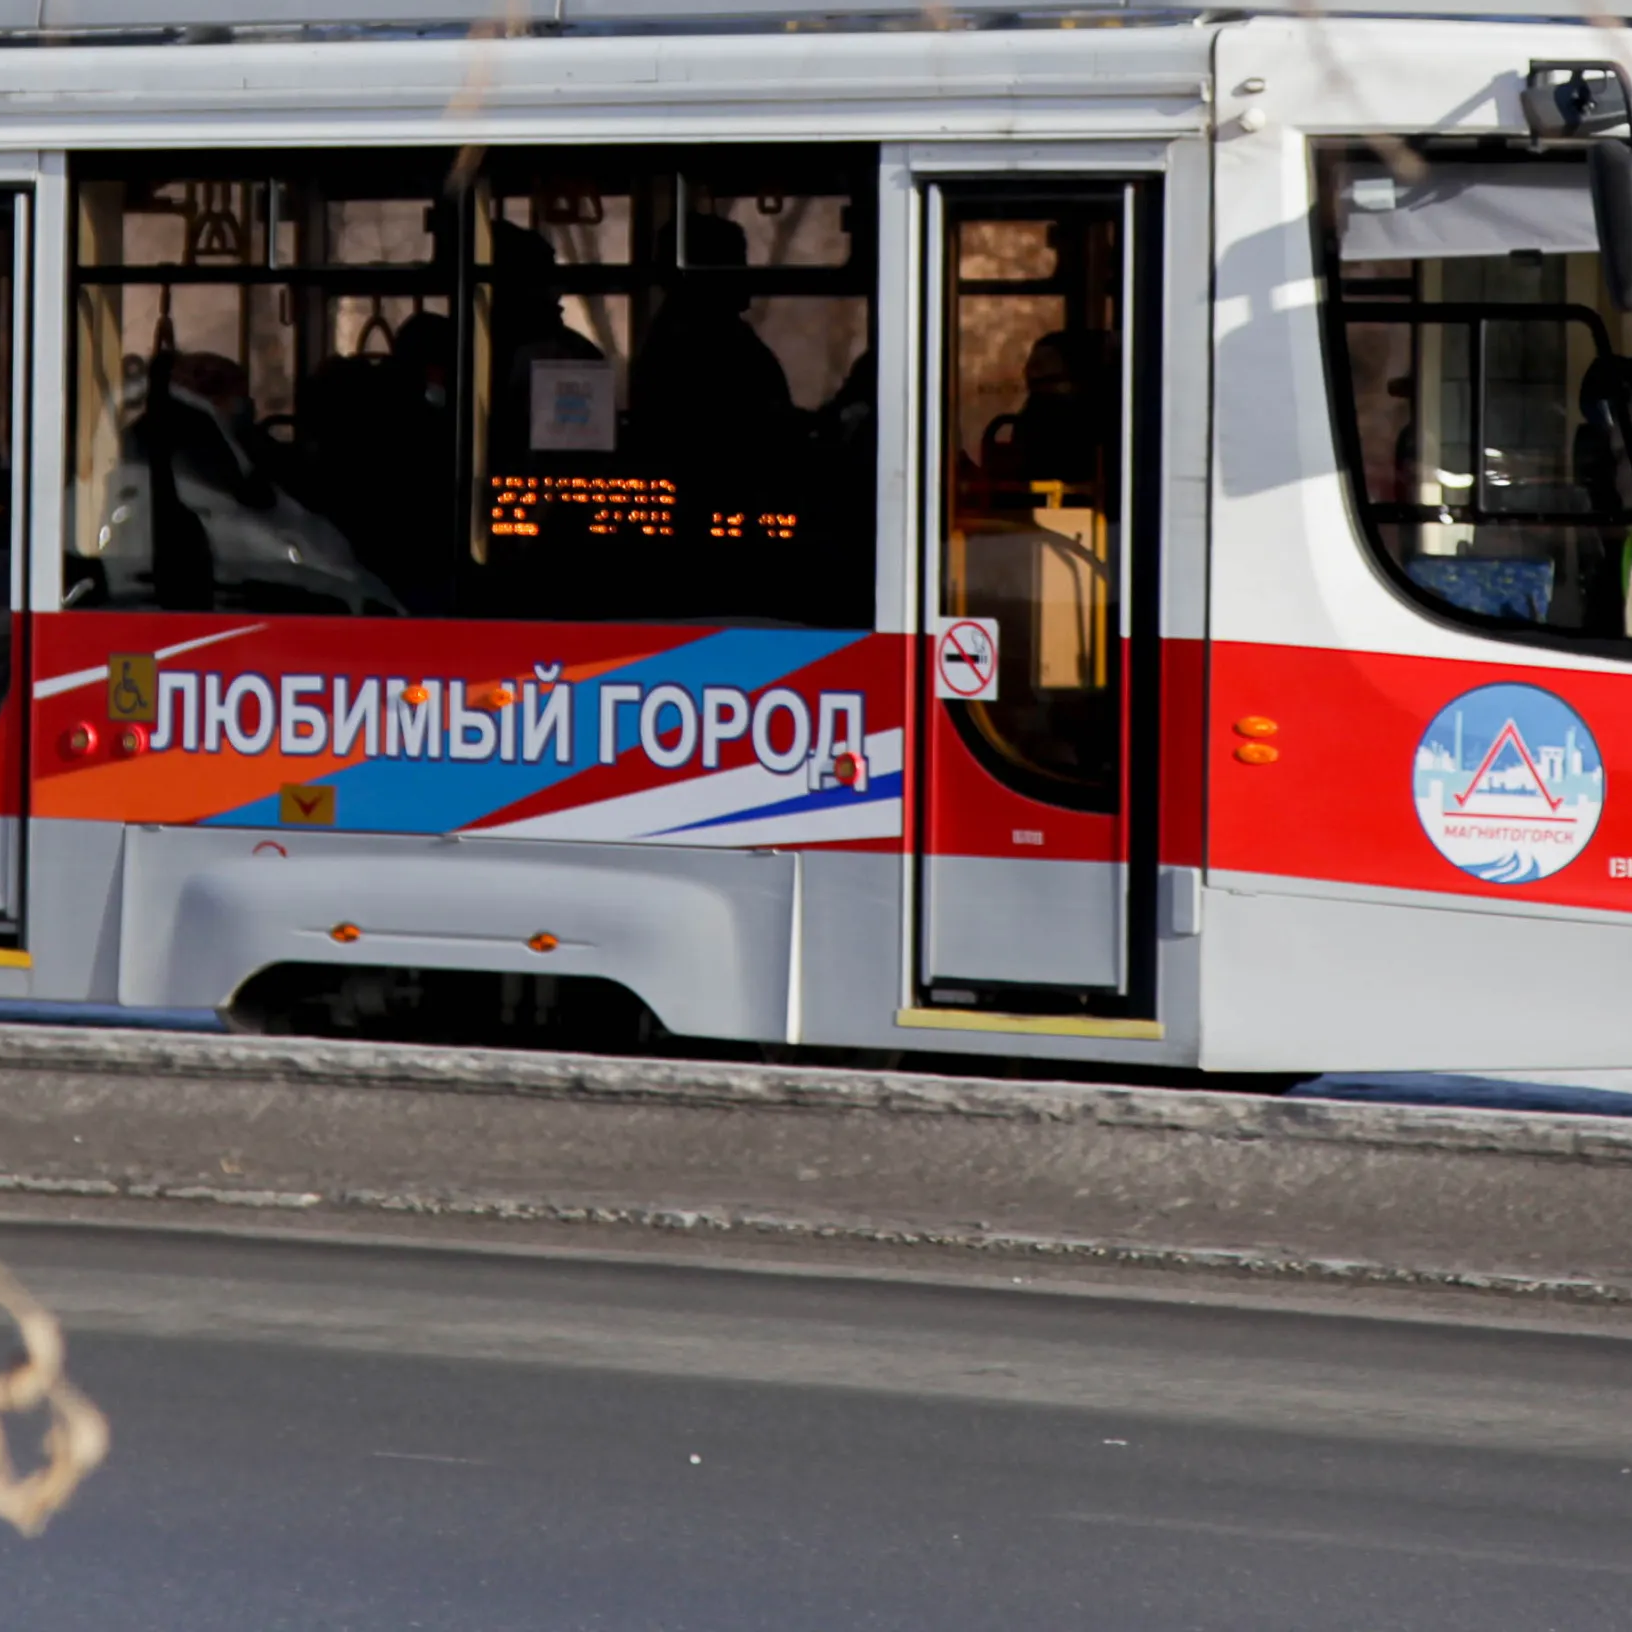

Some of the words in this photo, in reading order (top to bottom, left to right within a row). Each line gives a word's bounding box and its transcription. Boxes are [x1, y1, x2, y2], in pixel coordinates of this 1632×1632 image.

[149, 661, 573, 764] ЛЮБИМЫЙ
[596, 682, 869, 795] ГОРОД
[1443, 824, 1575, 845] МАГНИТОГОРСК
